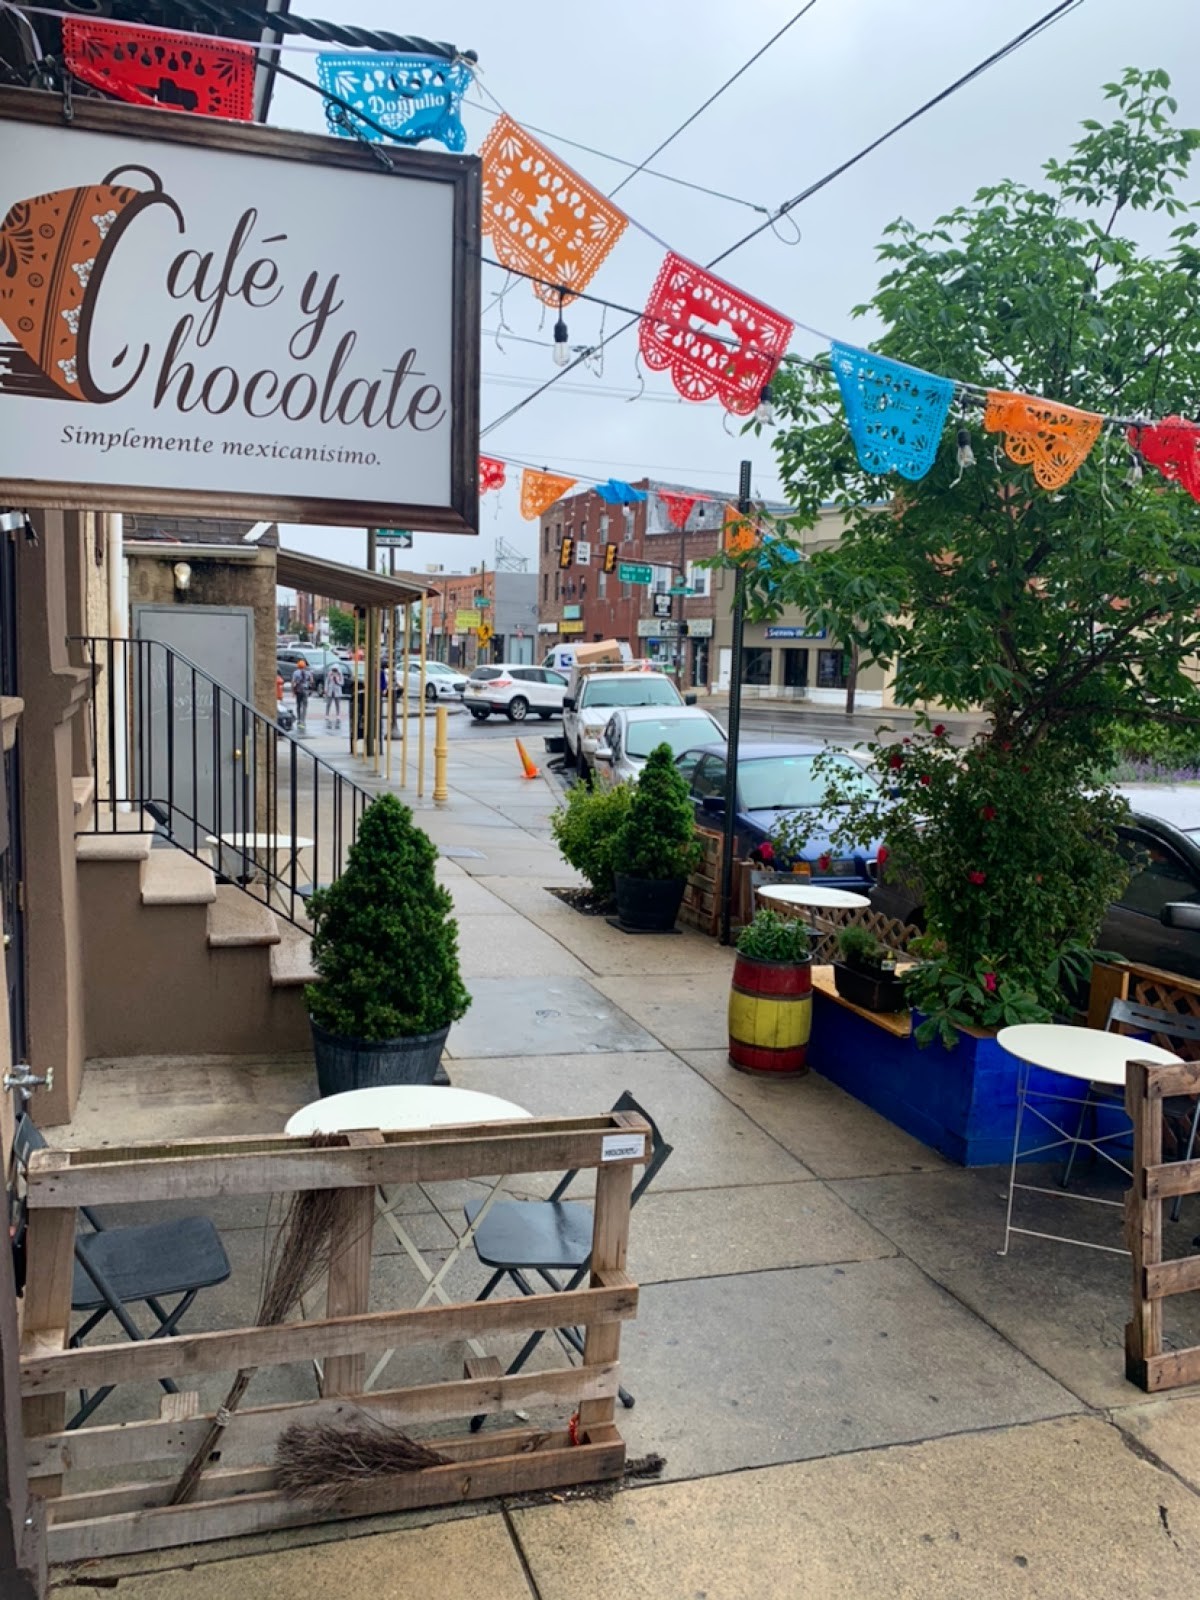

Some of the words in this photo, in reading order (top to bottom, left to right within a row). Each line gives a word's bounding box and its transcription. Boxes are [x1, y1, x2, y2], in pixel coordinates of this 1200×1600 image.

[403, 93, 445, 119] Julio
[76, 190, 287, 365] Café
[289, 270, 344, 360] y
[76, 298, 446, 432] Chocolate
[61, 425, 214, 453] Simplemente
